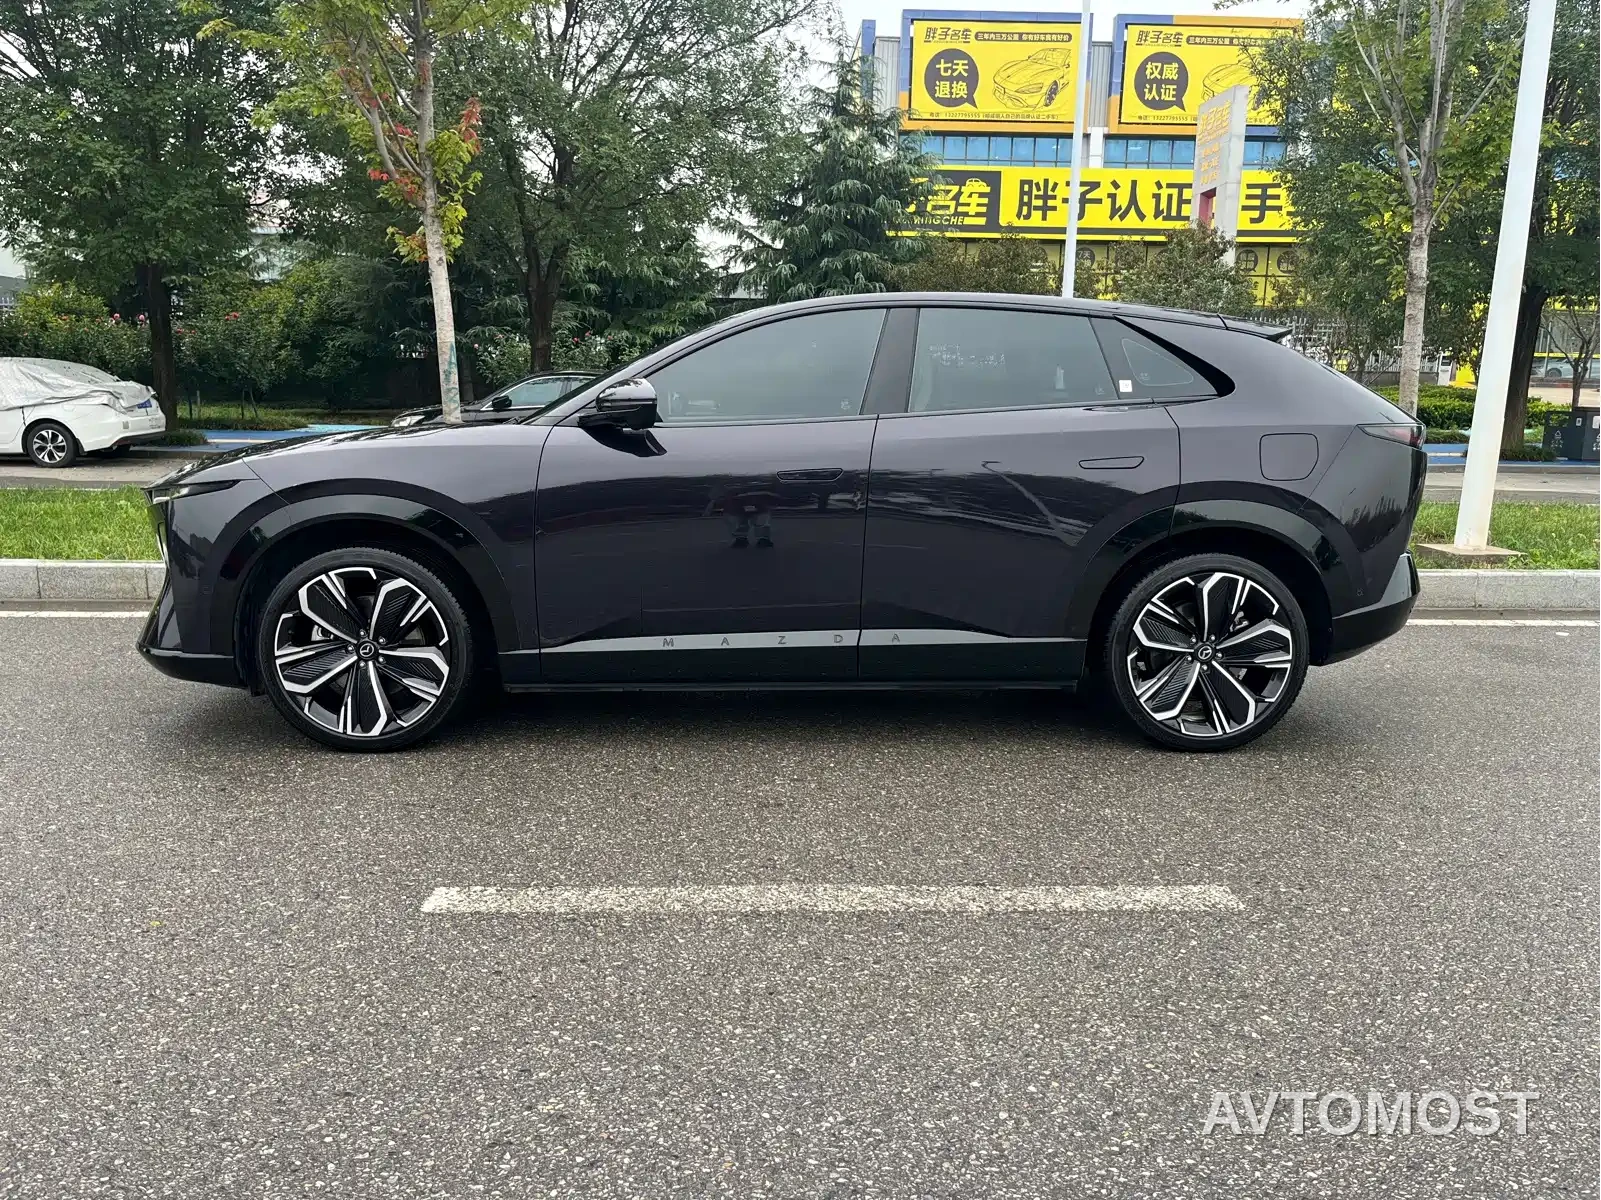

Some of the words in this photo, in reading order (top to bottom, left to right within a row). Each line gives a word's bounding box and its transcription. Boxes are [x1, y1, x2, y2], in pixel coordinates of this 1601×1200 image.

[925, 26, 972, 41] 胖子名车
[1136, 30, 1183, 43] 胖子名车
[935, 58, 969, 77] 七天
[1145, 61, 1179, 80] 权威
[934, 80, 968, 98] 退换
[1143, 83, 1177, 101] 认证
[662, 633, 902, 648] MAZDA
